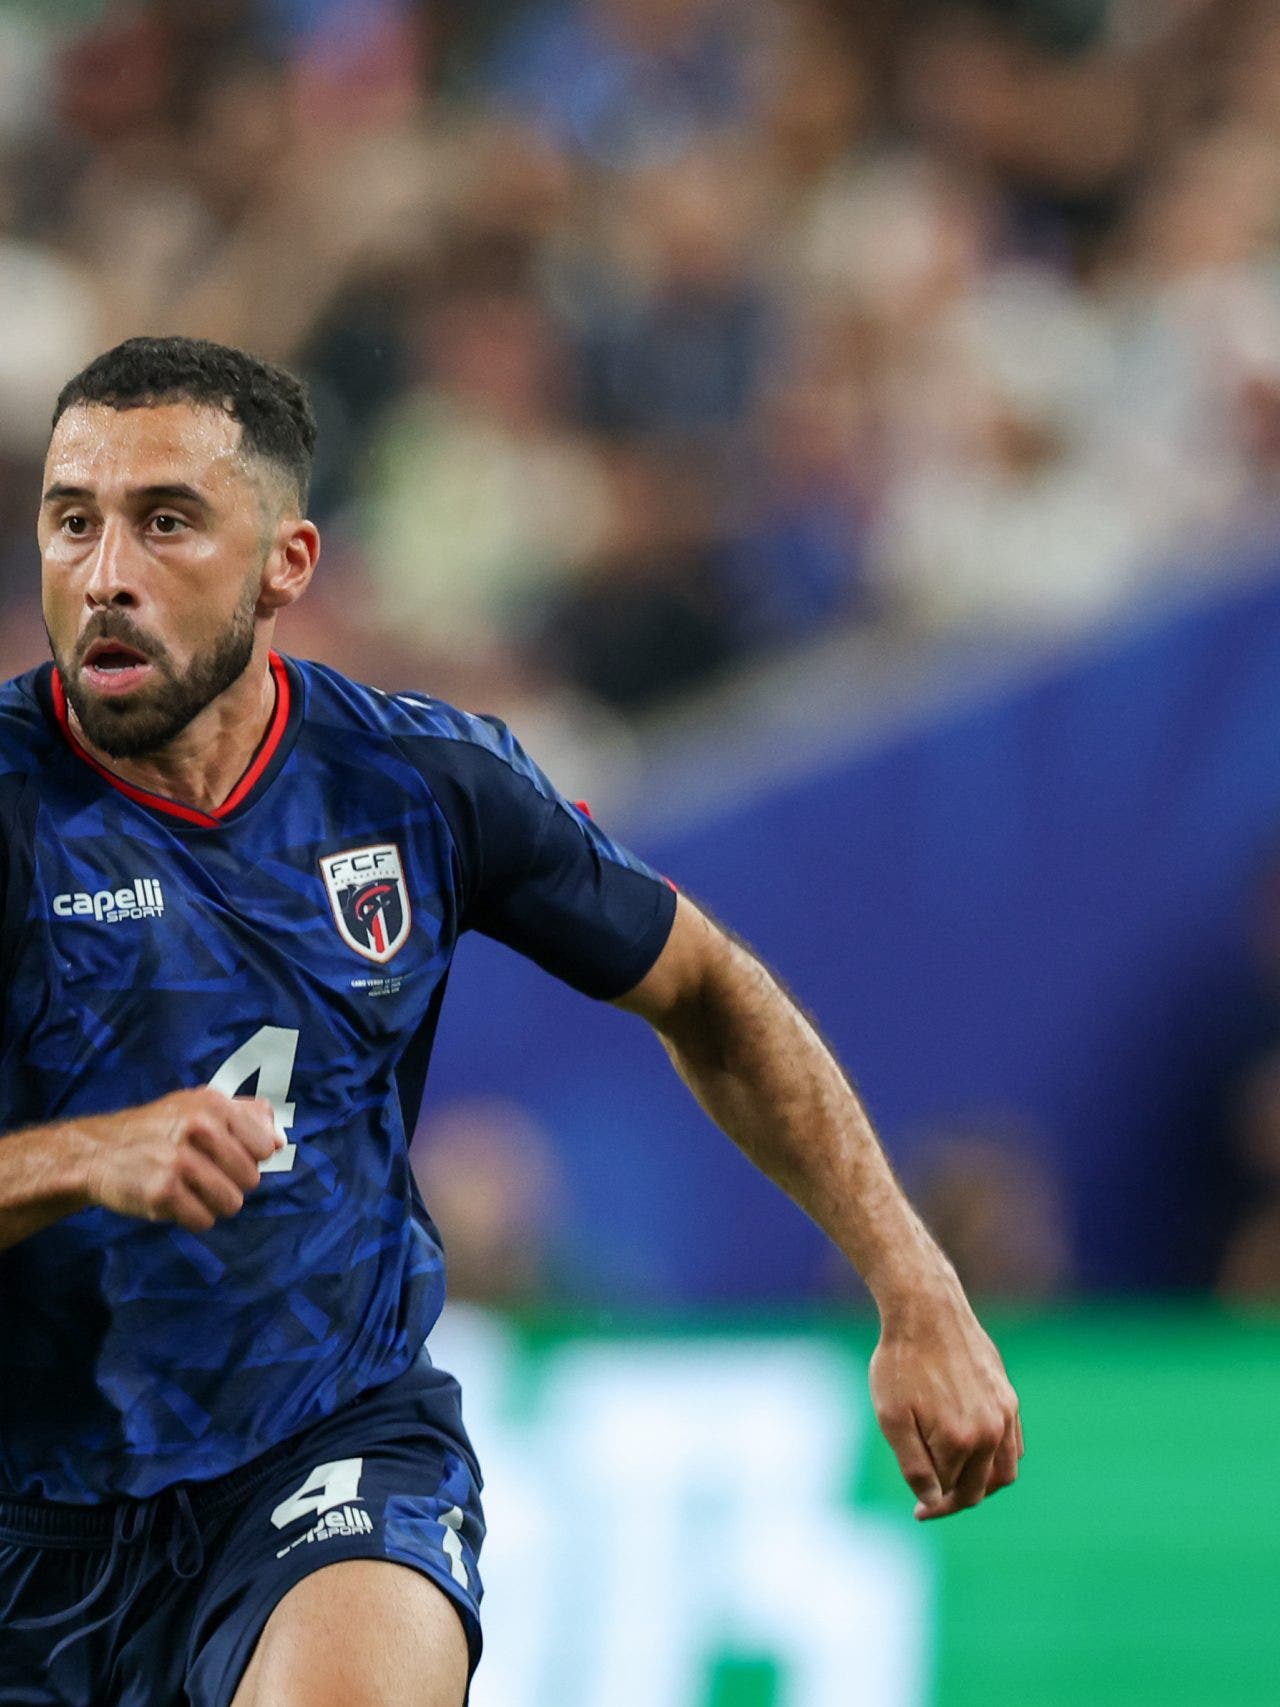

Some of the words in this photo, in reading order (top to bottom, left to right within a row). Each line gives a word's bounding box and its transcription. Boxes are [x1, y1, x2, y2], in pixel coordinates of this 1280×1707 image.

[330, 851, 392, 879] FCF
[53, 878, 164, 921] capelli
[106, 906, 164, 923] SPORT
[207, 1025, 300, 1173] 4
[270, 1457, 366, 1531] 4
